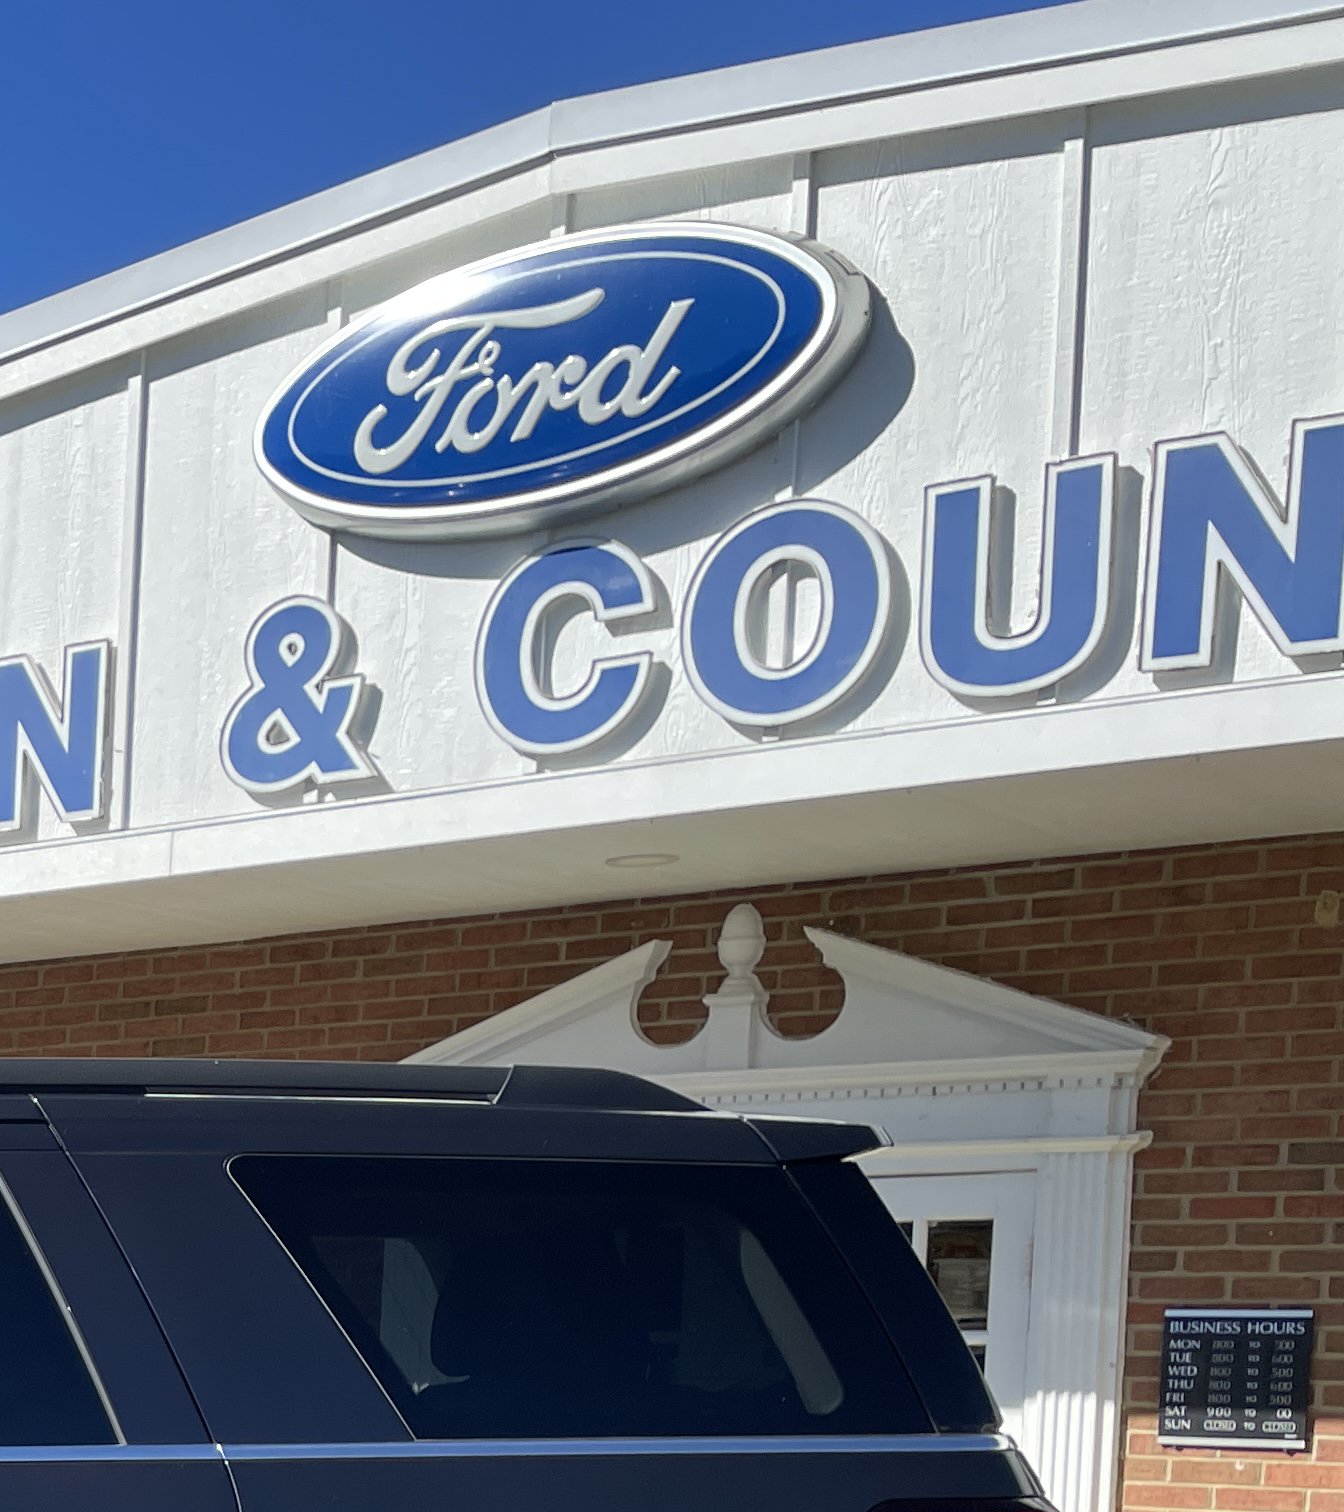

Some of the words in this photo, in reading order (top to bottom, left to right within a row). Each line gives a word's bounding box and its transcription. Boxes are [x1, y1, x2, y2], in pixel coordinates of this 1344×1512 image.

[353, 288, 696, 474] Ford
[219, 594, 379, 795] &
[475, 414, 1344, 755] COUN
[1170, 1321, 1241, 1334] BUSINESS
[1247, 1321, 1306, 1335] HOURS
[1169, 1340, 1201, 1349] MON
[1170, 1352, 1192, 1362] TUE
[1168, 1366, 1198, 1376] WED
[1168, 1379, 1194, 1390] THU
[1166, 1392, 1184, 1403] FRI
[1165, 1405, 1187, 1416] SAT
[1164, 1419, 1191, 1430] SUN
